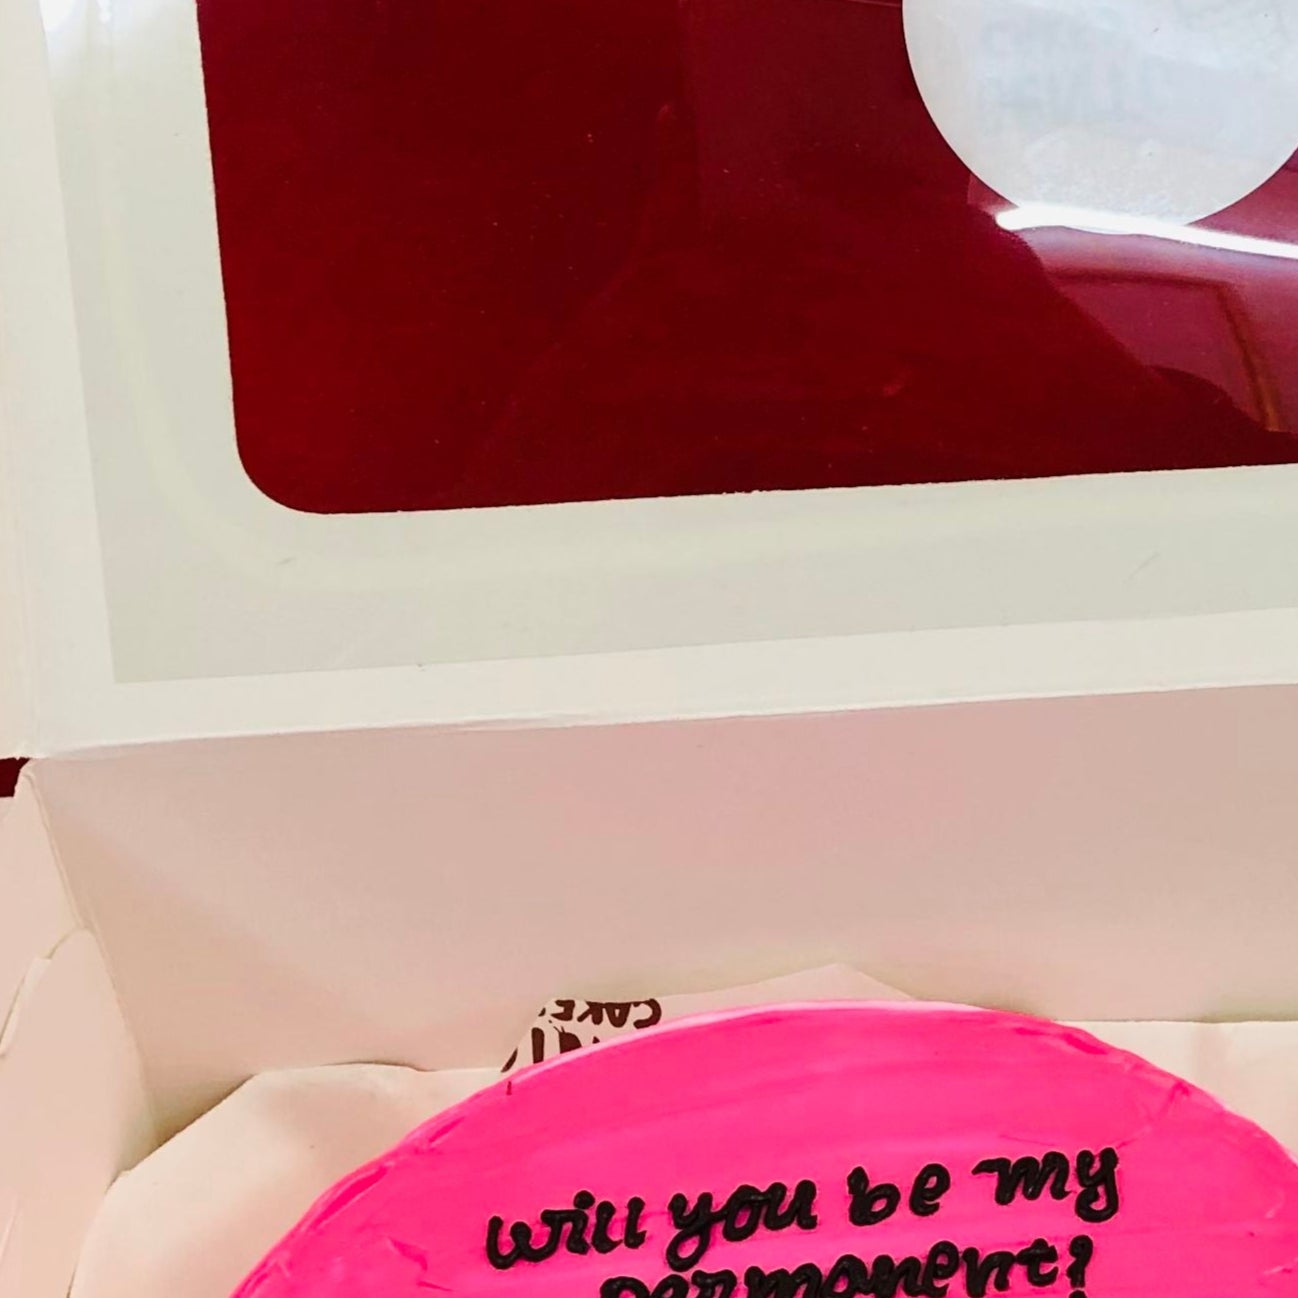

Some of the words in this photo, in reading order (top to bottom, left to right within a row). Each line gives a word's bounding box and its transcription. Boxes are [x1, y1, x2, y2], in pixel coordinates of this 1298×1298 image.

[486, 1190, 648, 1269] will
[665, 1179, 818, 1272] you
[846, 1163, 952, 1226] be
[972, 1146, 1119, 1223] my
